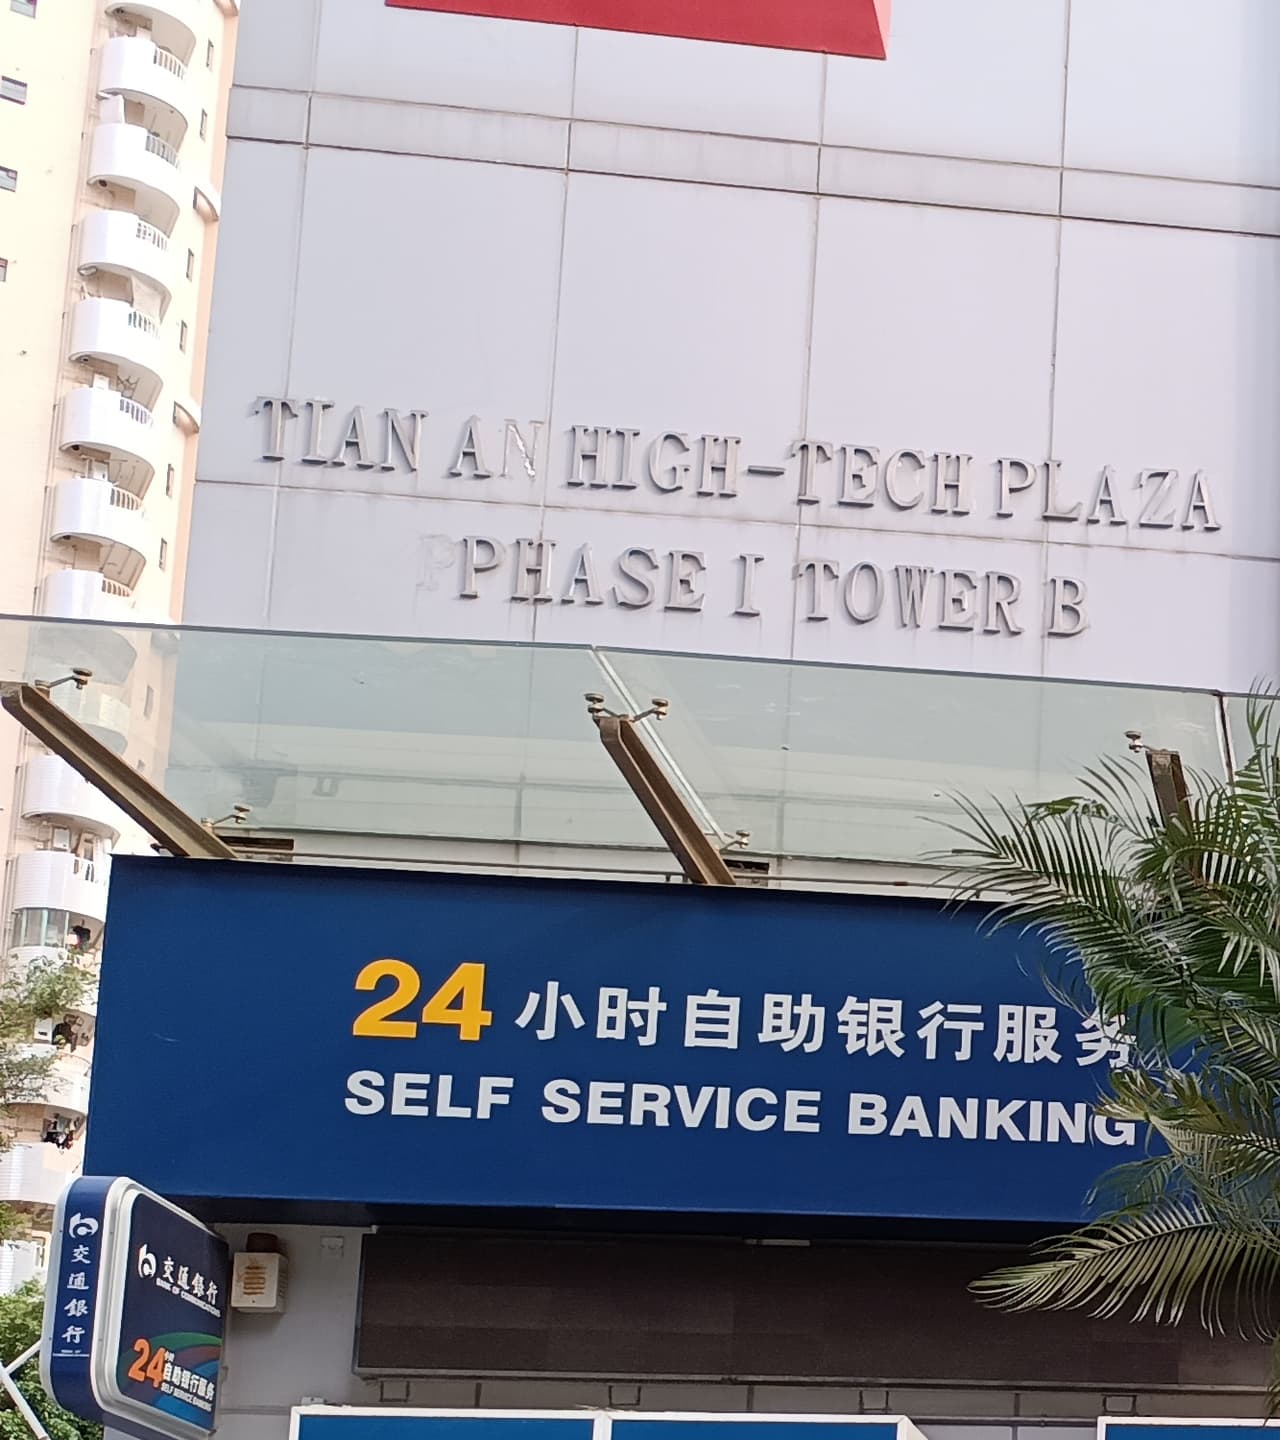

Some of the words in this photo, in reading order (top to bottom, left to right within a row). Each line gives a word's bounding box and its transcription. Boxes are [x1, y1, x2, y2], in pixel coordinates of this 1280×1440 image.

[255, 397, 429, 473] TIAN
[449, 413, 543, 480] AN
[567, 423, 972, 518] HIGH-TECH
[995, 454, 1223, 533] PLAZA
[458, 532, 706, 615] PHASE
[734, 551, 766, 616] I
[799, 558, 1027, 638] TOWER
[1045, 574, 1090, 638] B
[353, 959, 491, 1041] 24
[345, 1070, 514, 1119] SELF
[541, 1078, 821, 1135] SERVICE
[847, 1094, 1137, 1147] BANKING
[128, 1338, 166, 1388] 24
